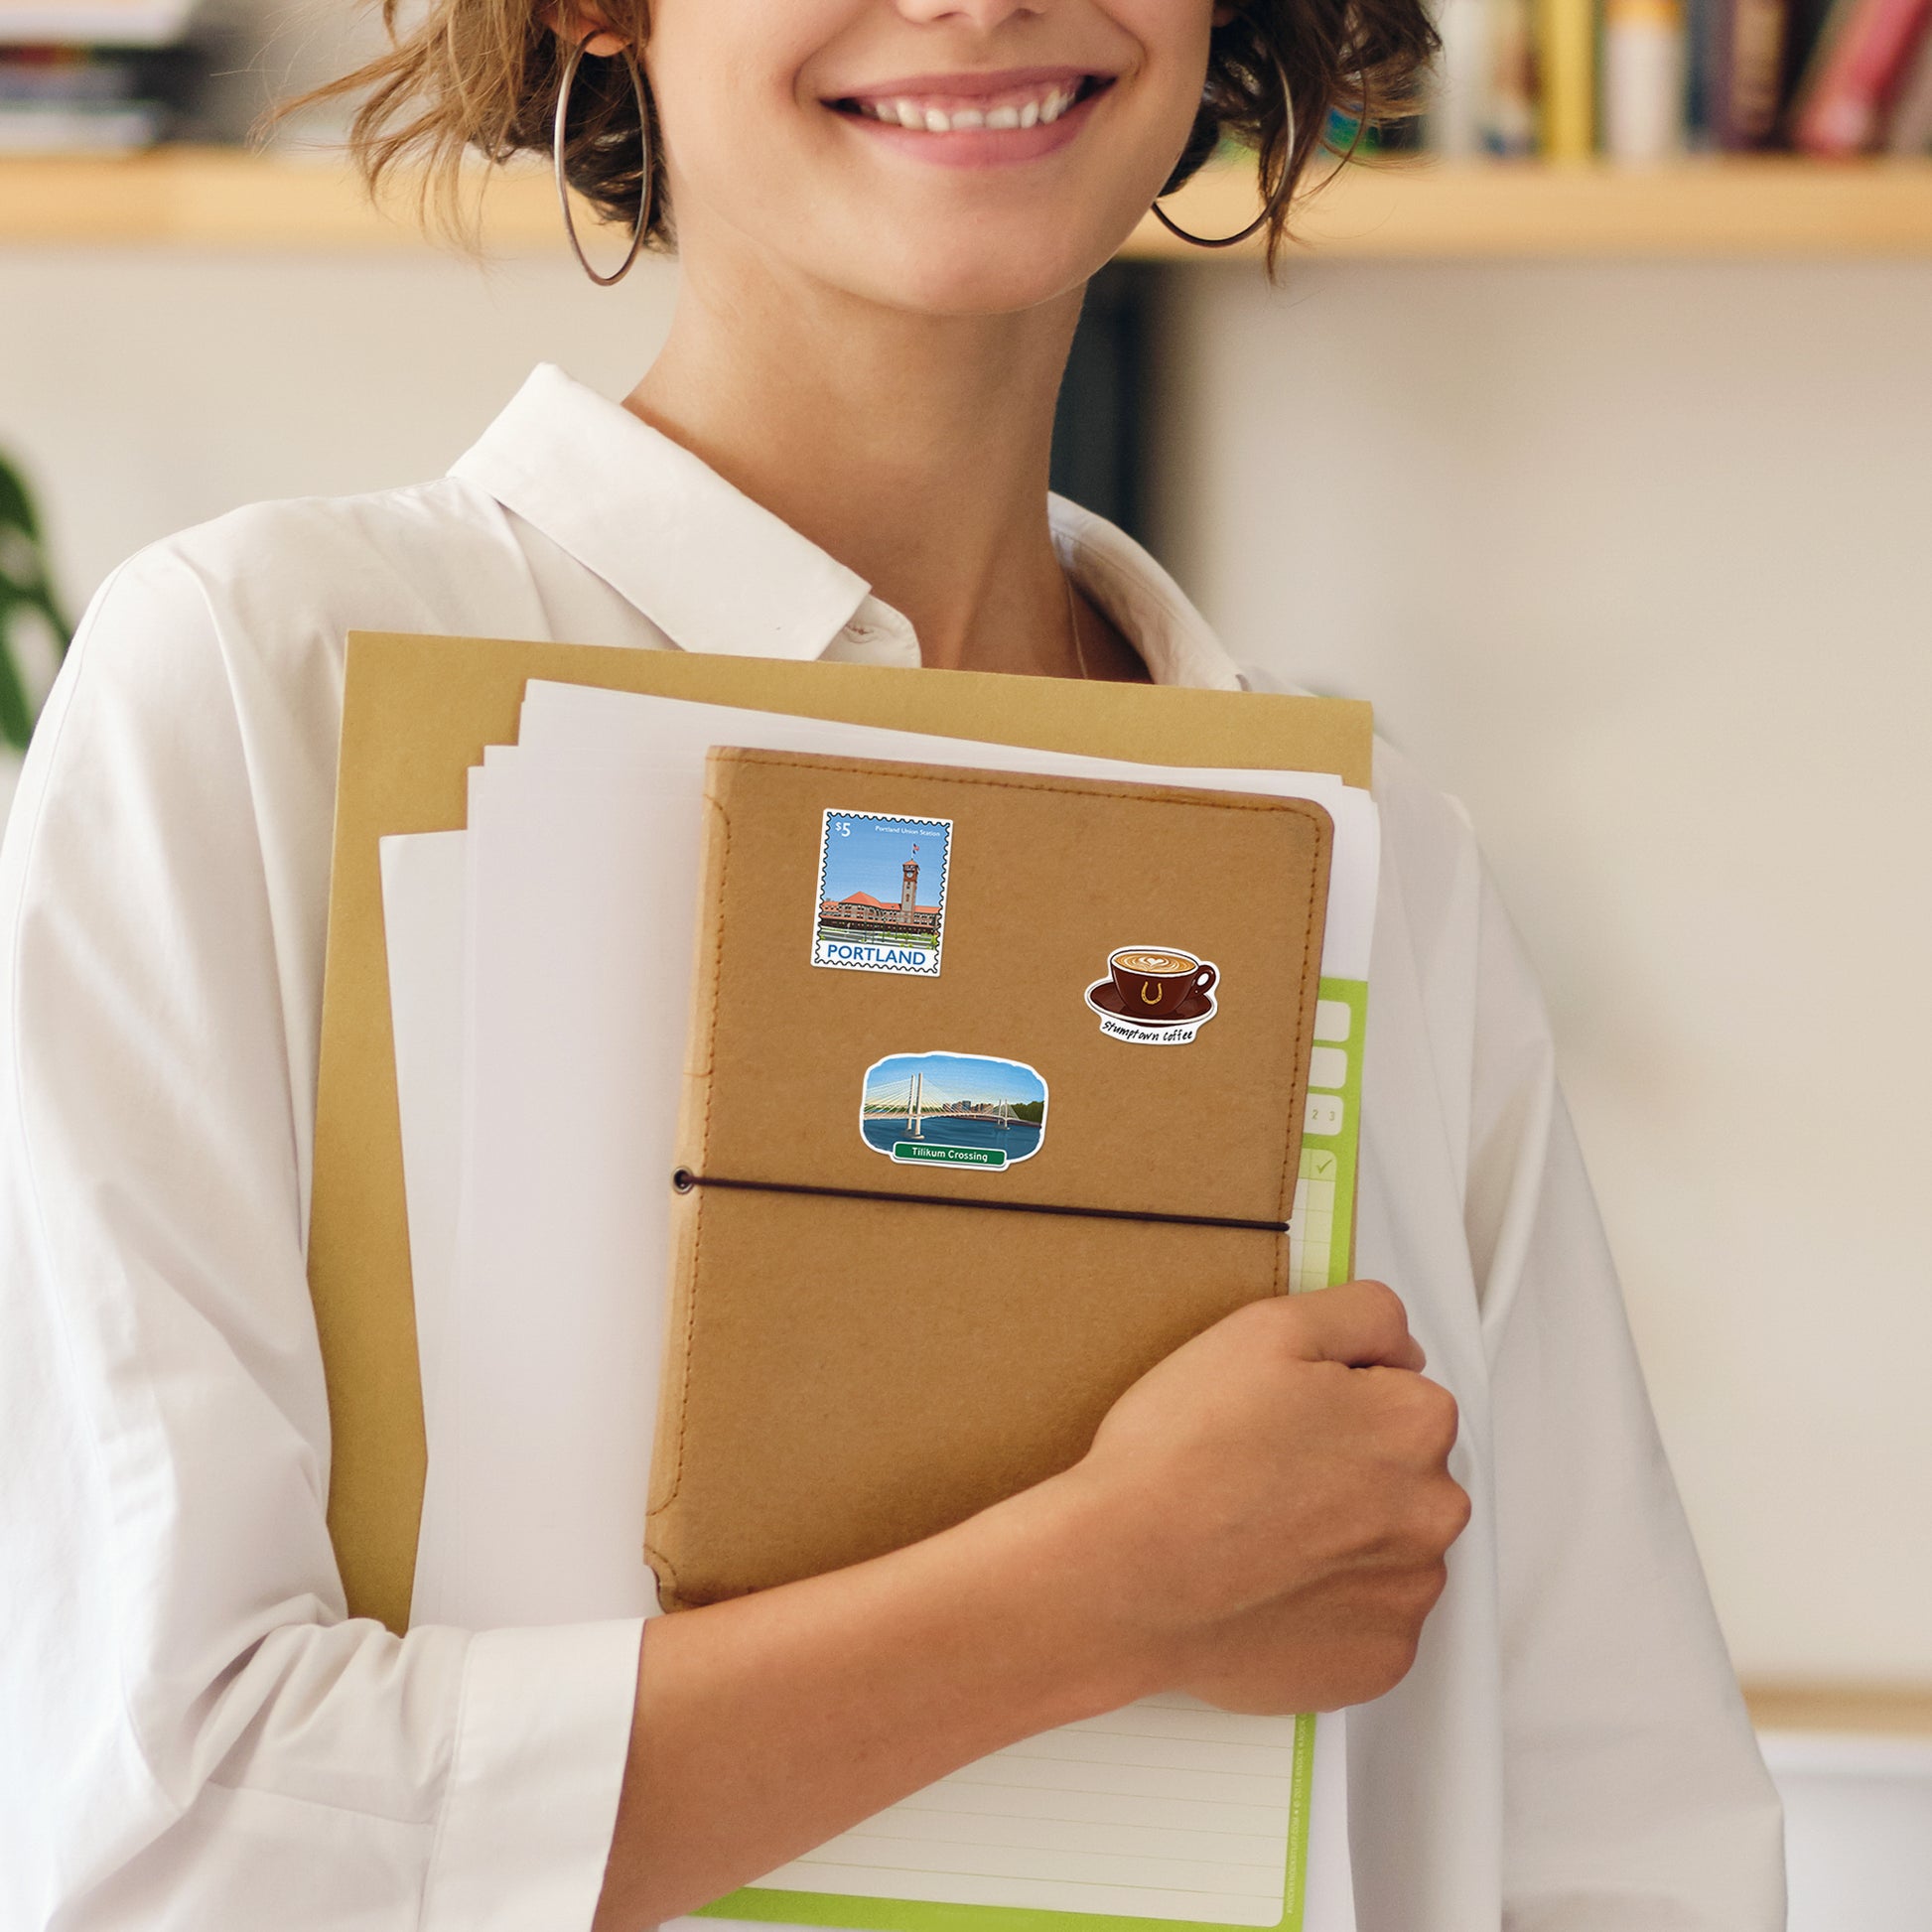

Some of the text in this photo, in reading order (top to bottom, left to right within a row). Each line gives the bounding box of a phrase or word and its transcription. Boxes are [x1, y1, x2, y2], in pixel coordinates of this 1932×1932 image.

[835, 821, 851, 837] $5
[875, 825, 900, 834] Portland
[919, 828, 941, 837] Station
[827, 944, 926, 965] PORTLAND
[1102, 1021, 1160, 1041] Stumptown
[911, 1147, 989, 1163] Tilikum Crossing
